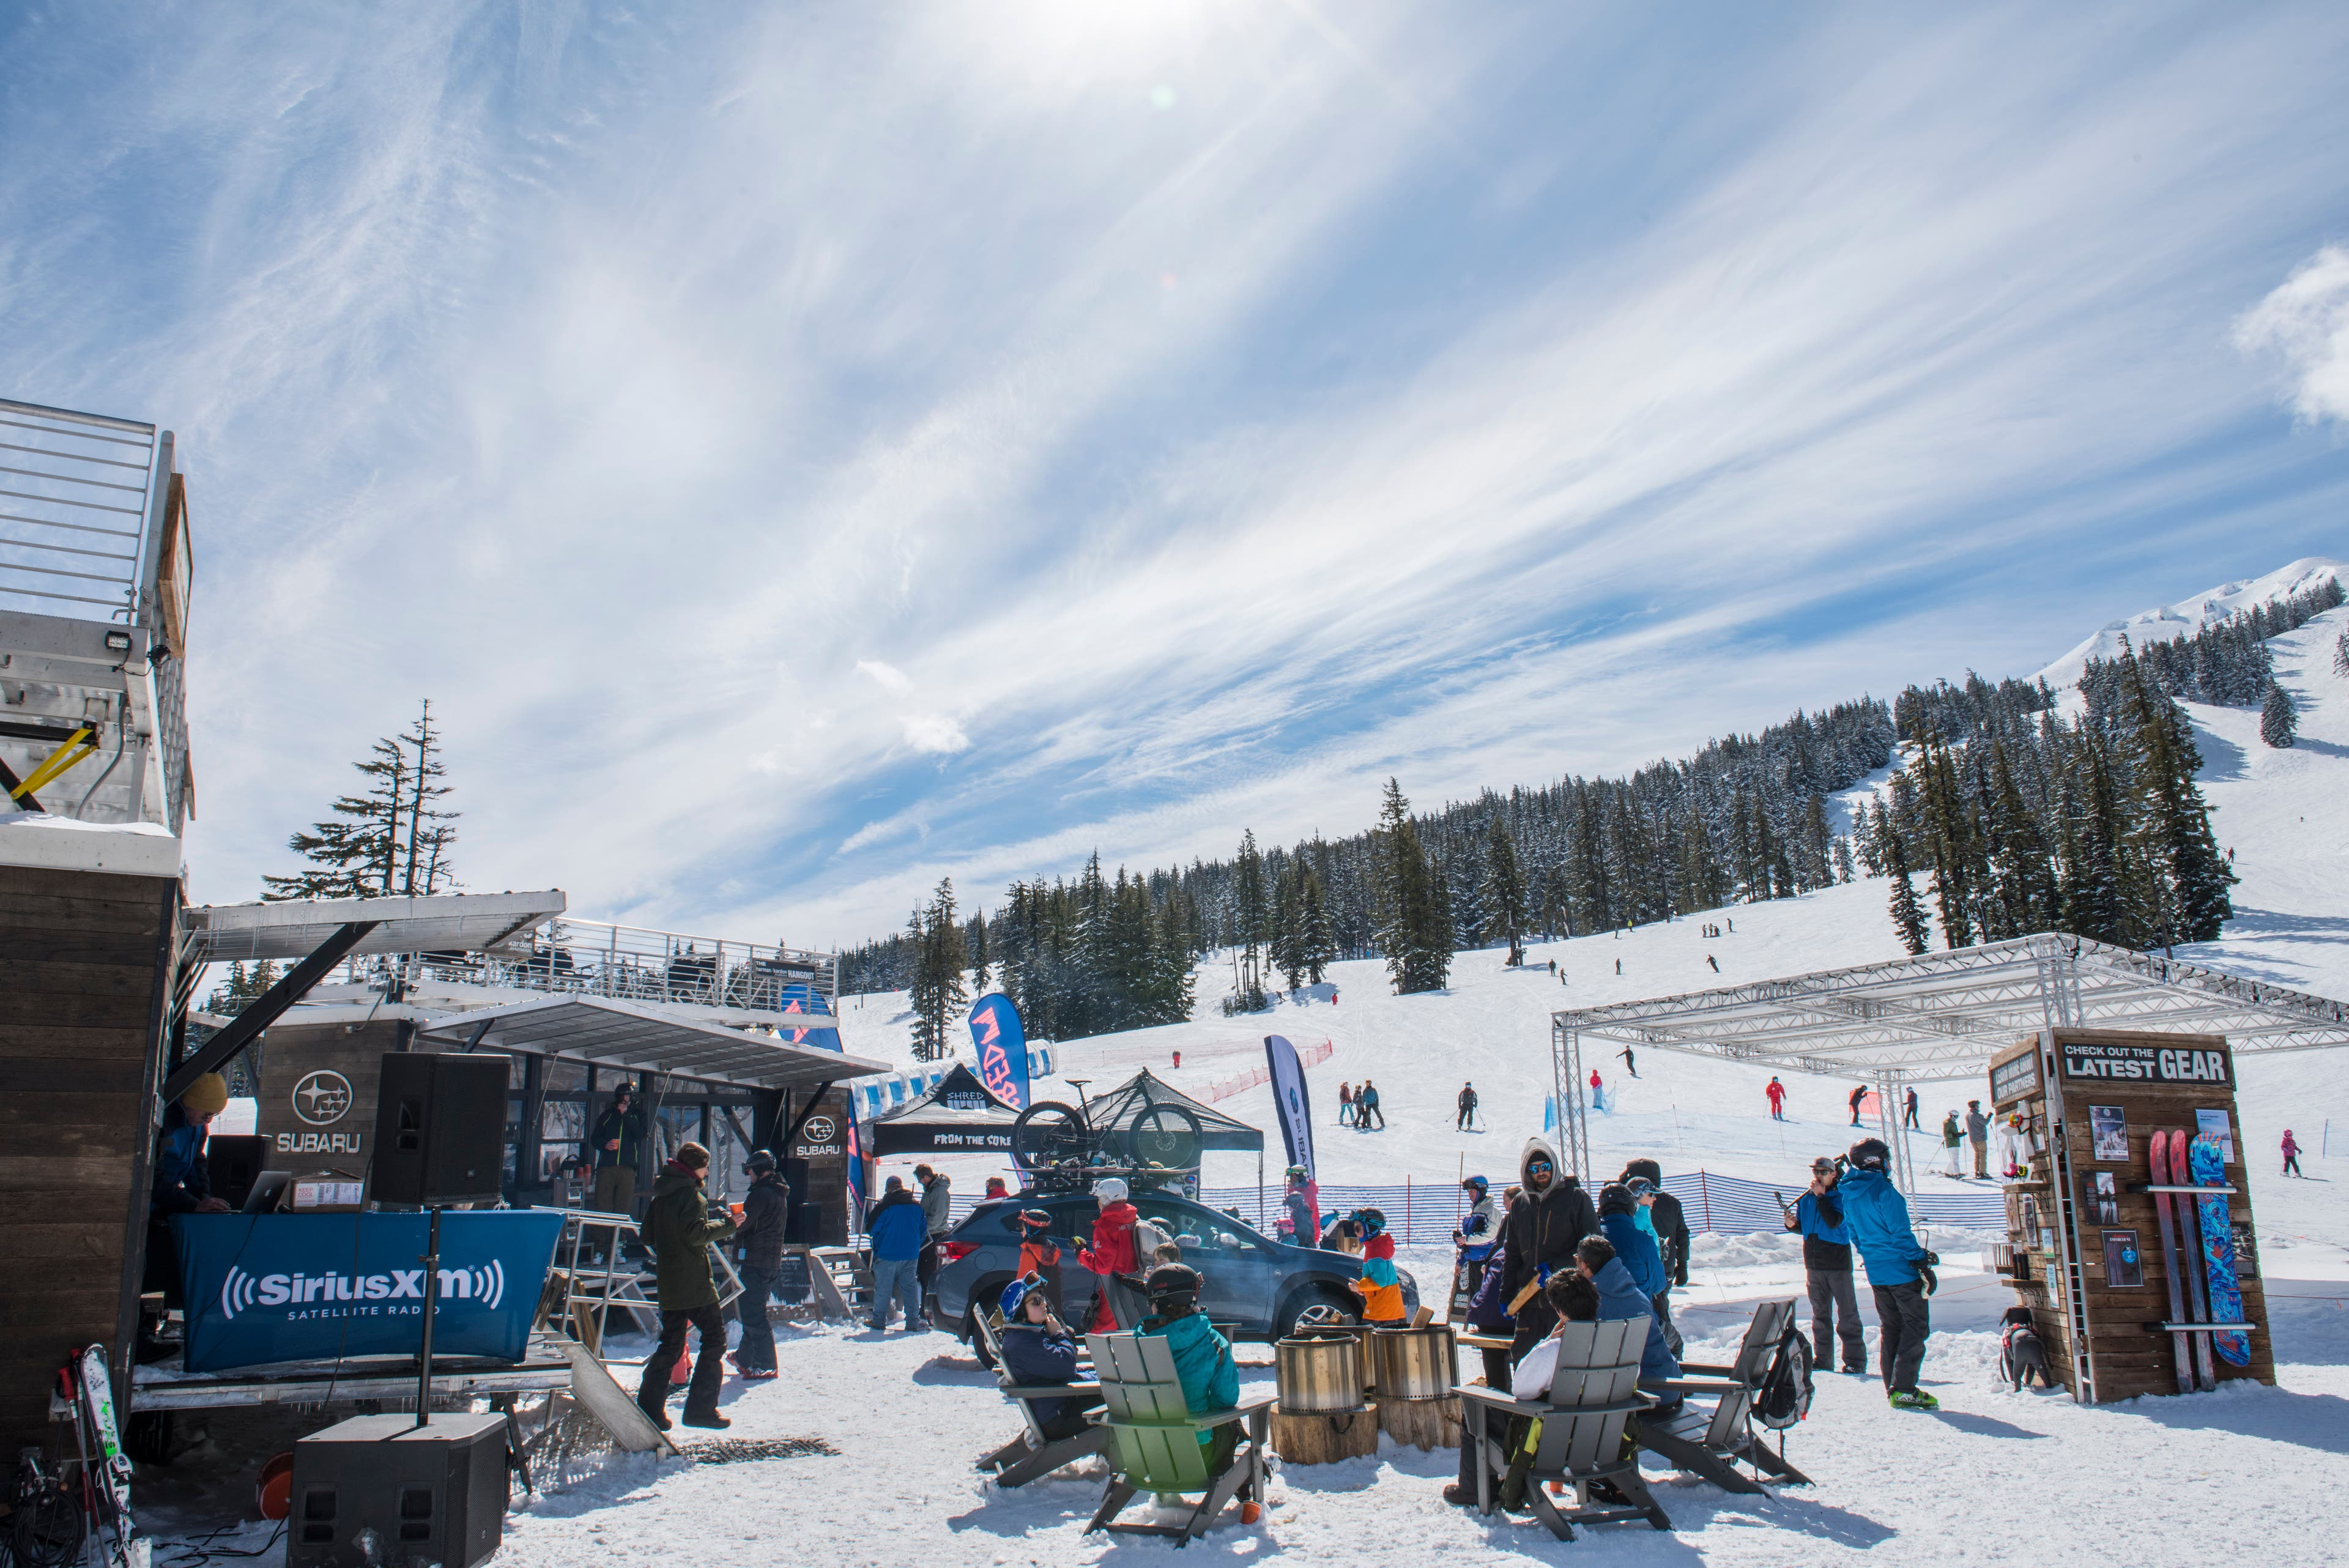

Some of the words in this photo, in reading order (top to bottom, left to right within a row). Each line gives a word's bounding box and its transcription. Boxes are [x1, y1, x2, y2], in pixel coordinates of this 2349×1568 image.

[788, 970, 814, 980] HANGOUT
[2065, 1046, 2104, 1055] CHECK
[2107, 1047, 2130, 1057] OUT
[2132, 1049, 2154, 1058] THE
[1995, 1065, 2008, 1085] LEARN
[2019, 1052, 2034, 1074] ABOUT
[2066, 1058, 2156, 1078] LATEST
[2159, 1049, 2226, 1081] GEAR
[1997, 1084, 2008, 1100] OUR
[2008, 1072, 2036, 1095] PARTNERS
[277, 1133, 360, 1153] SUBARU
[934, 1134, 963, 1146] FROM
[965, 1135, 985, 1145] THE
[987, 1134, 1011, 1146] CORE
[796, 1145, 840, 1156] SUBARU
[288, 1306, 378, 1320] SATELLITE
